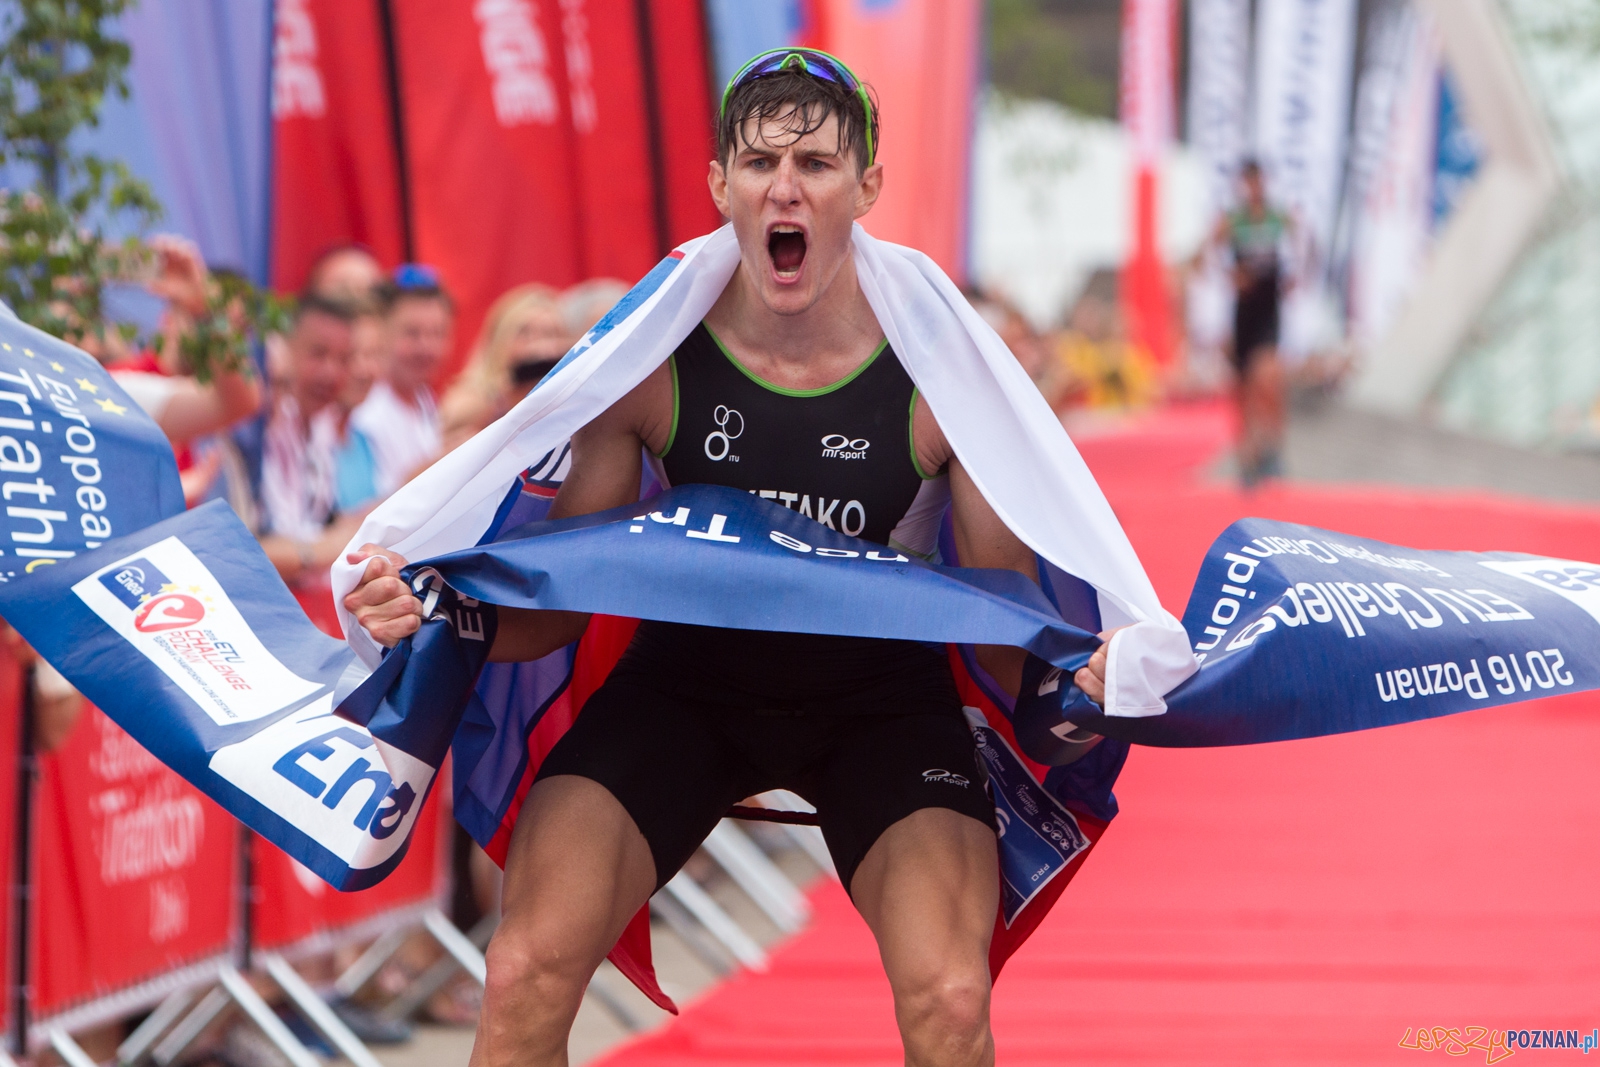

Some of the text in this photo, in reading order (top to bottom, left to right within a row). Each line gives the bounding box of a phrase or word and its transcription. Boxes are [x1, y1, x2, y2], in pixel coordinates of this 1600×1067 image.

[728, 454, 740, 463] ITU
[749, 489, 866, 537] TAKO
[1321, 540, 1453, 578] European
[114, 569, 145, 597] Enea
[1422, 587, 1535, 624] ETU
[184, 629, 252, 691] CHALLENGE
[213, 641, 245, 664] ETU
[1375, 648, 1574, 702] 2016 Poznan
[1031, 863, 1050, 882] PRO
